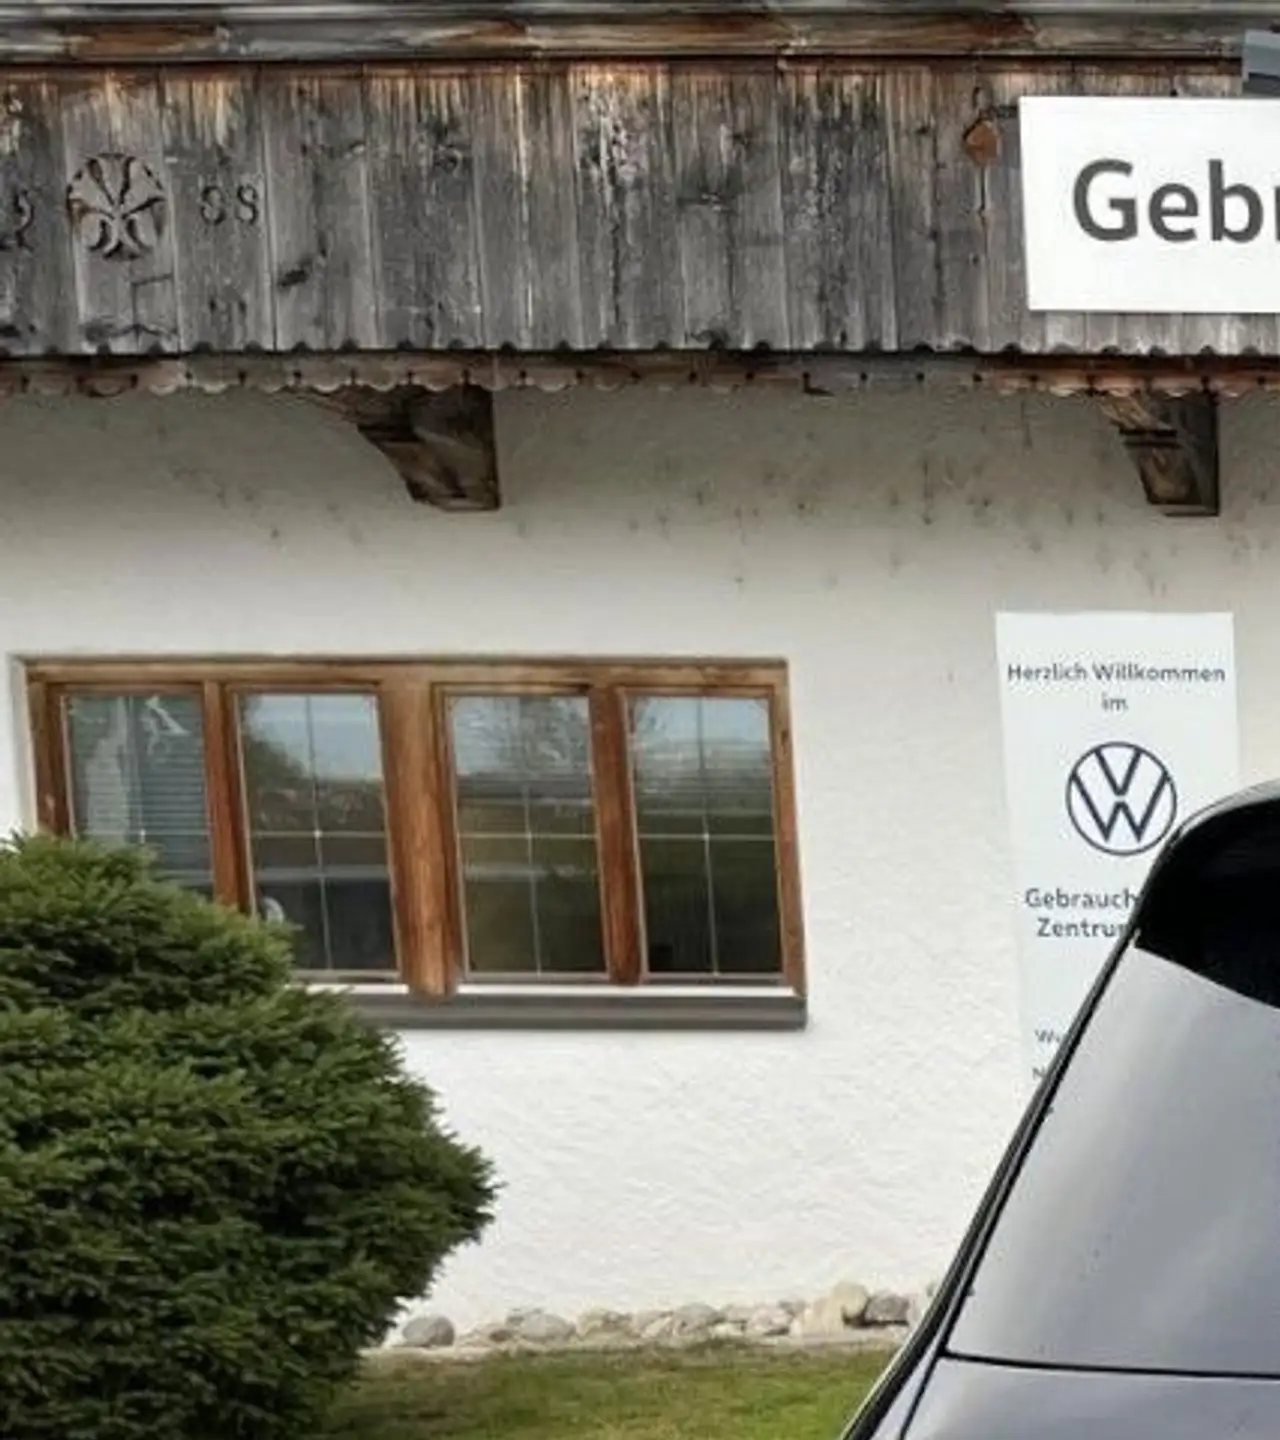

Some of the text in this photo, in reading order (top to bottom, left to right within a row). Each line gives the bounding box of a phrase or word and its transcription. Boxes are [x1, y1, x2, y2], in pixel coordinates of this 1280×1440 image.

[1006, 662, 1226, 684] Herzlich Willkommen
[1100, 693, 1129, 711] im
